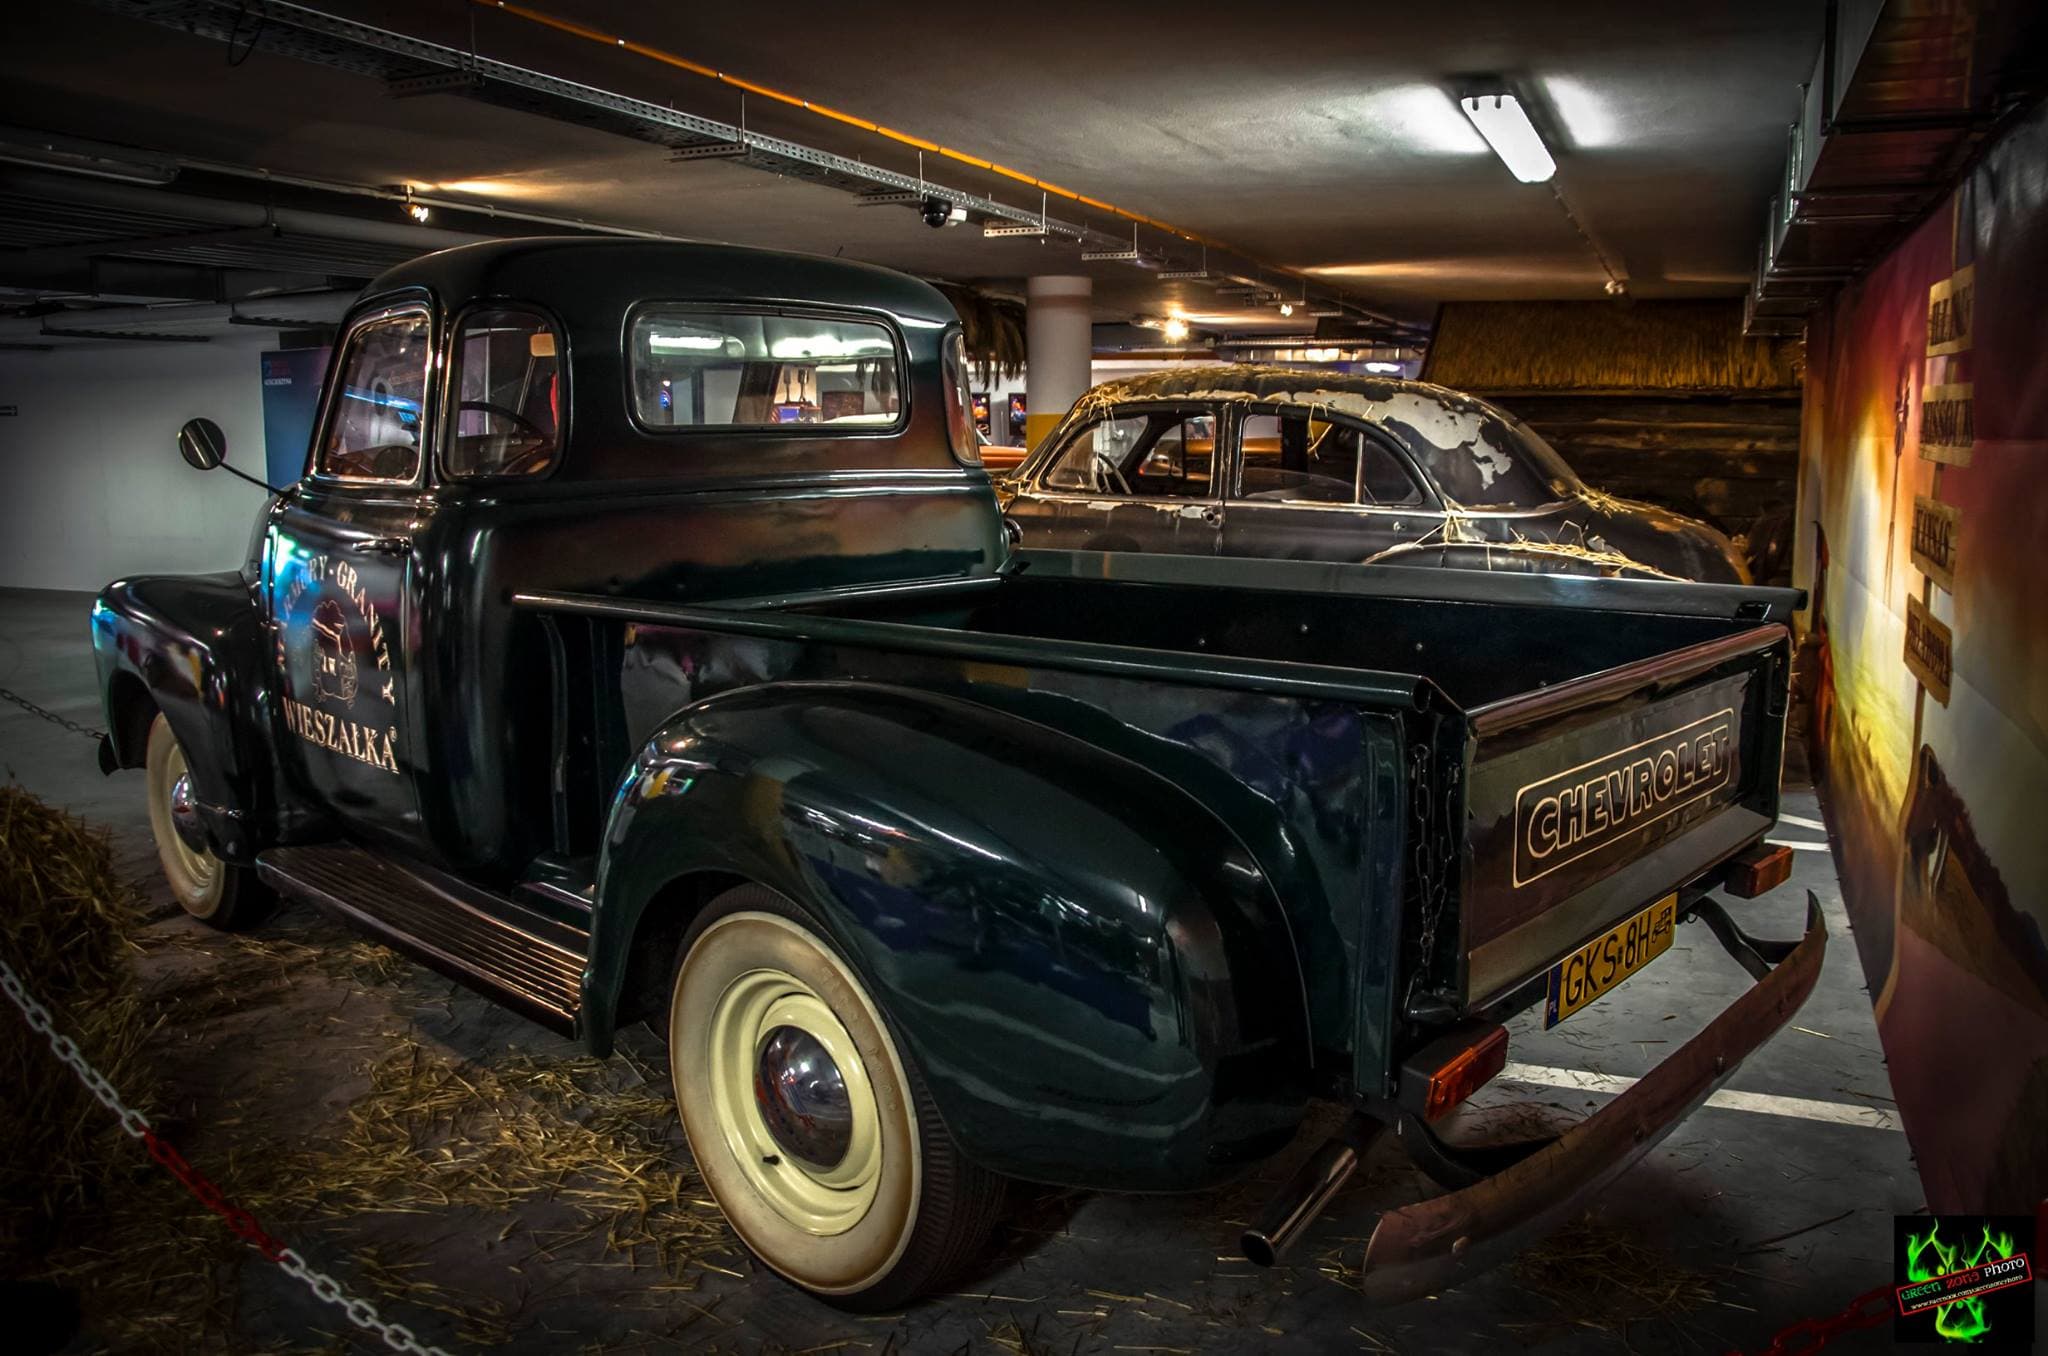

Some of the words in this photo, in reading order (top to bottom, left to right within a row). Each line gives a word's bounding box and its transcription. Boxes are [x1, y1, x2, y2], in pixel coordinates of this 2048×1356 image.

[1528, 724, 1729, 859] CHEVROLET
[1565, 933, 1618, 1007] GKS
[1624, 911, 1652, 969] 8H
